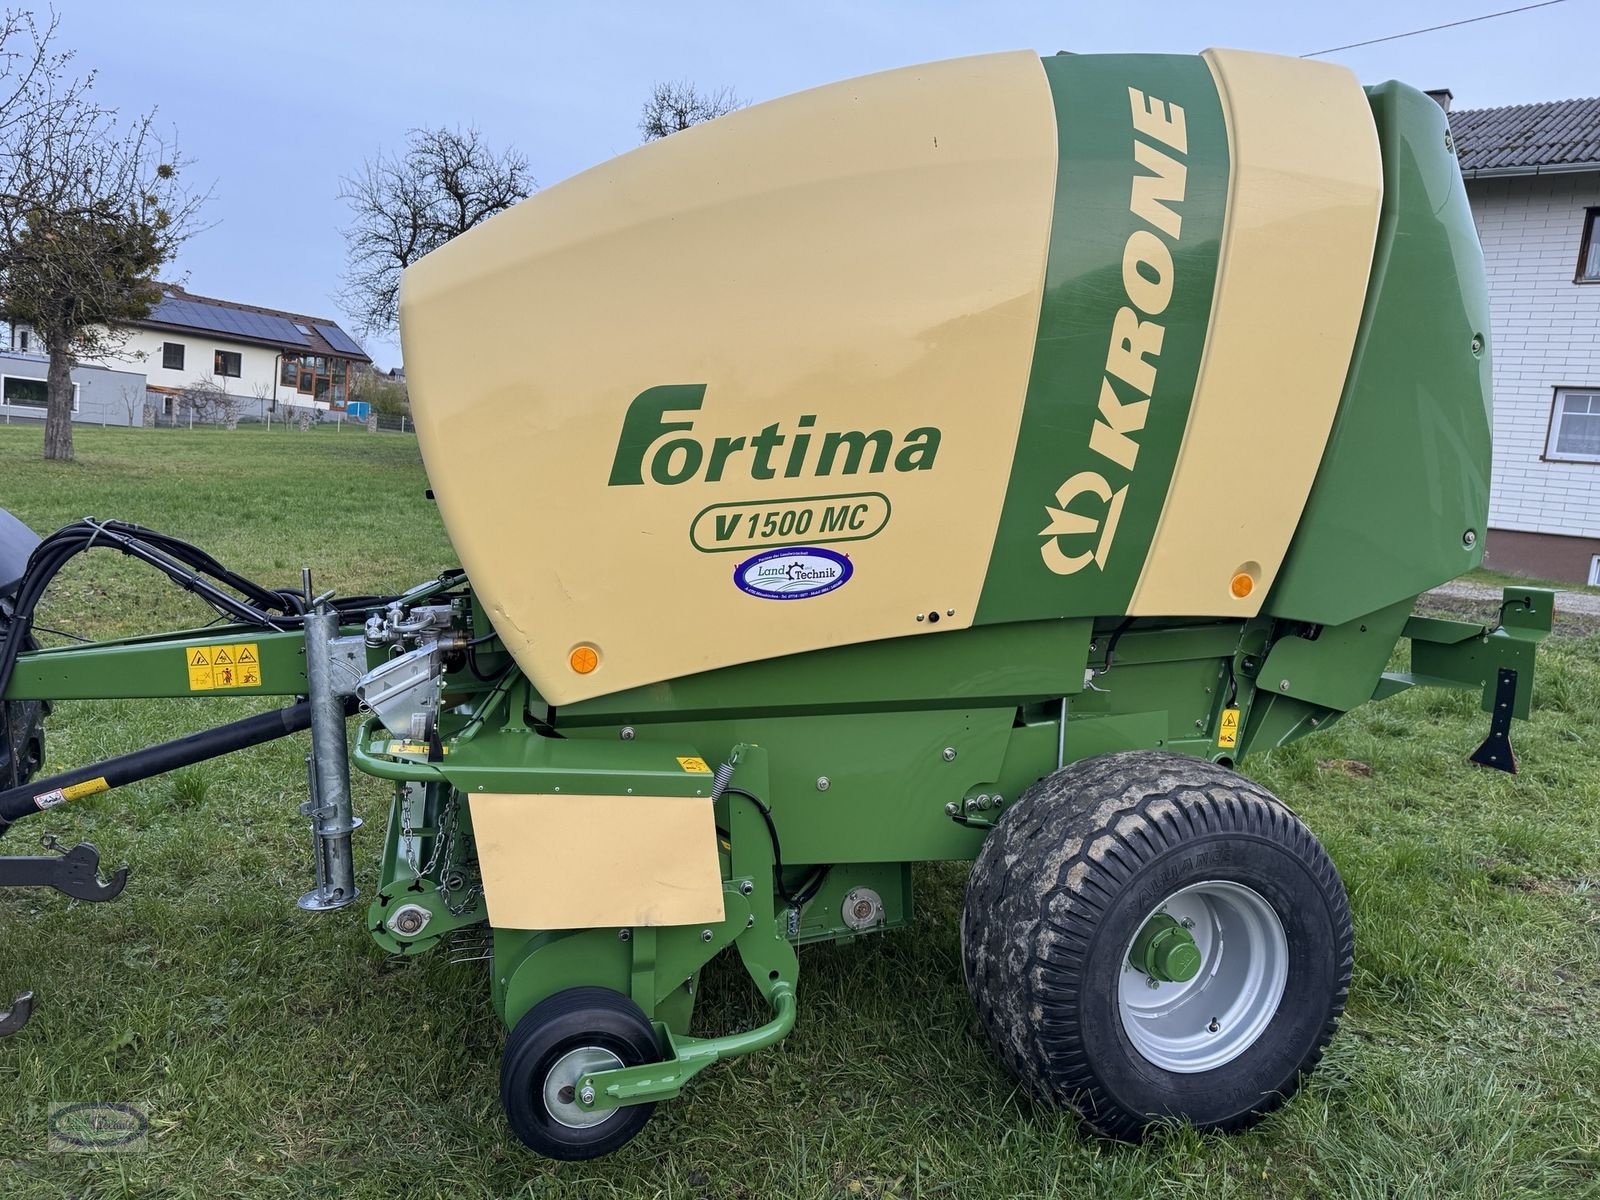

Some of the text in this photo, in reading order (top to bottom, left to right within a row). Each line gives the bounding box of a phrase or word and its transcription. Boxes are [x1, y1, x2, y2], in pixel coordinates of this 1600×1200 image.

[1089, 86, 1188, 471] KRONE
[608, 384, 942, 486] Fortima
[715, 503, 869, 541] V 1500 MC
[757, 564, 786, 577] Land
[795, 567, 836, 580] Technik
